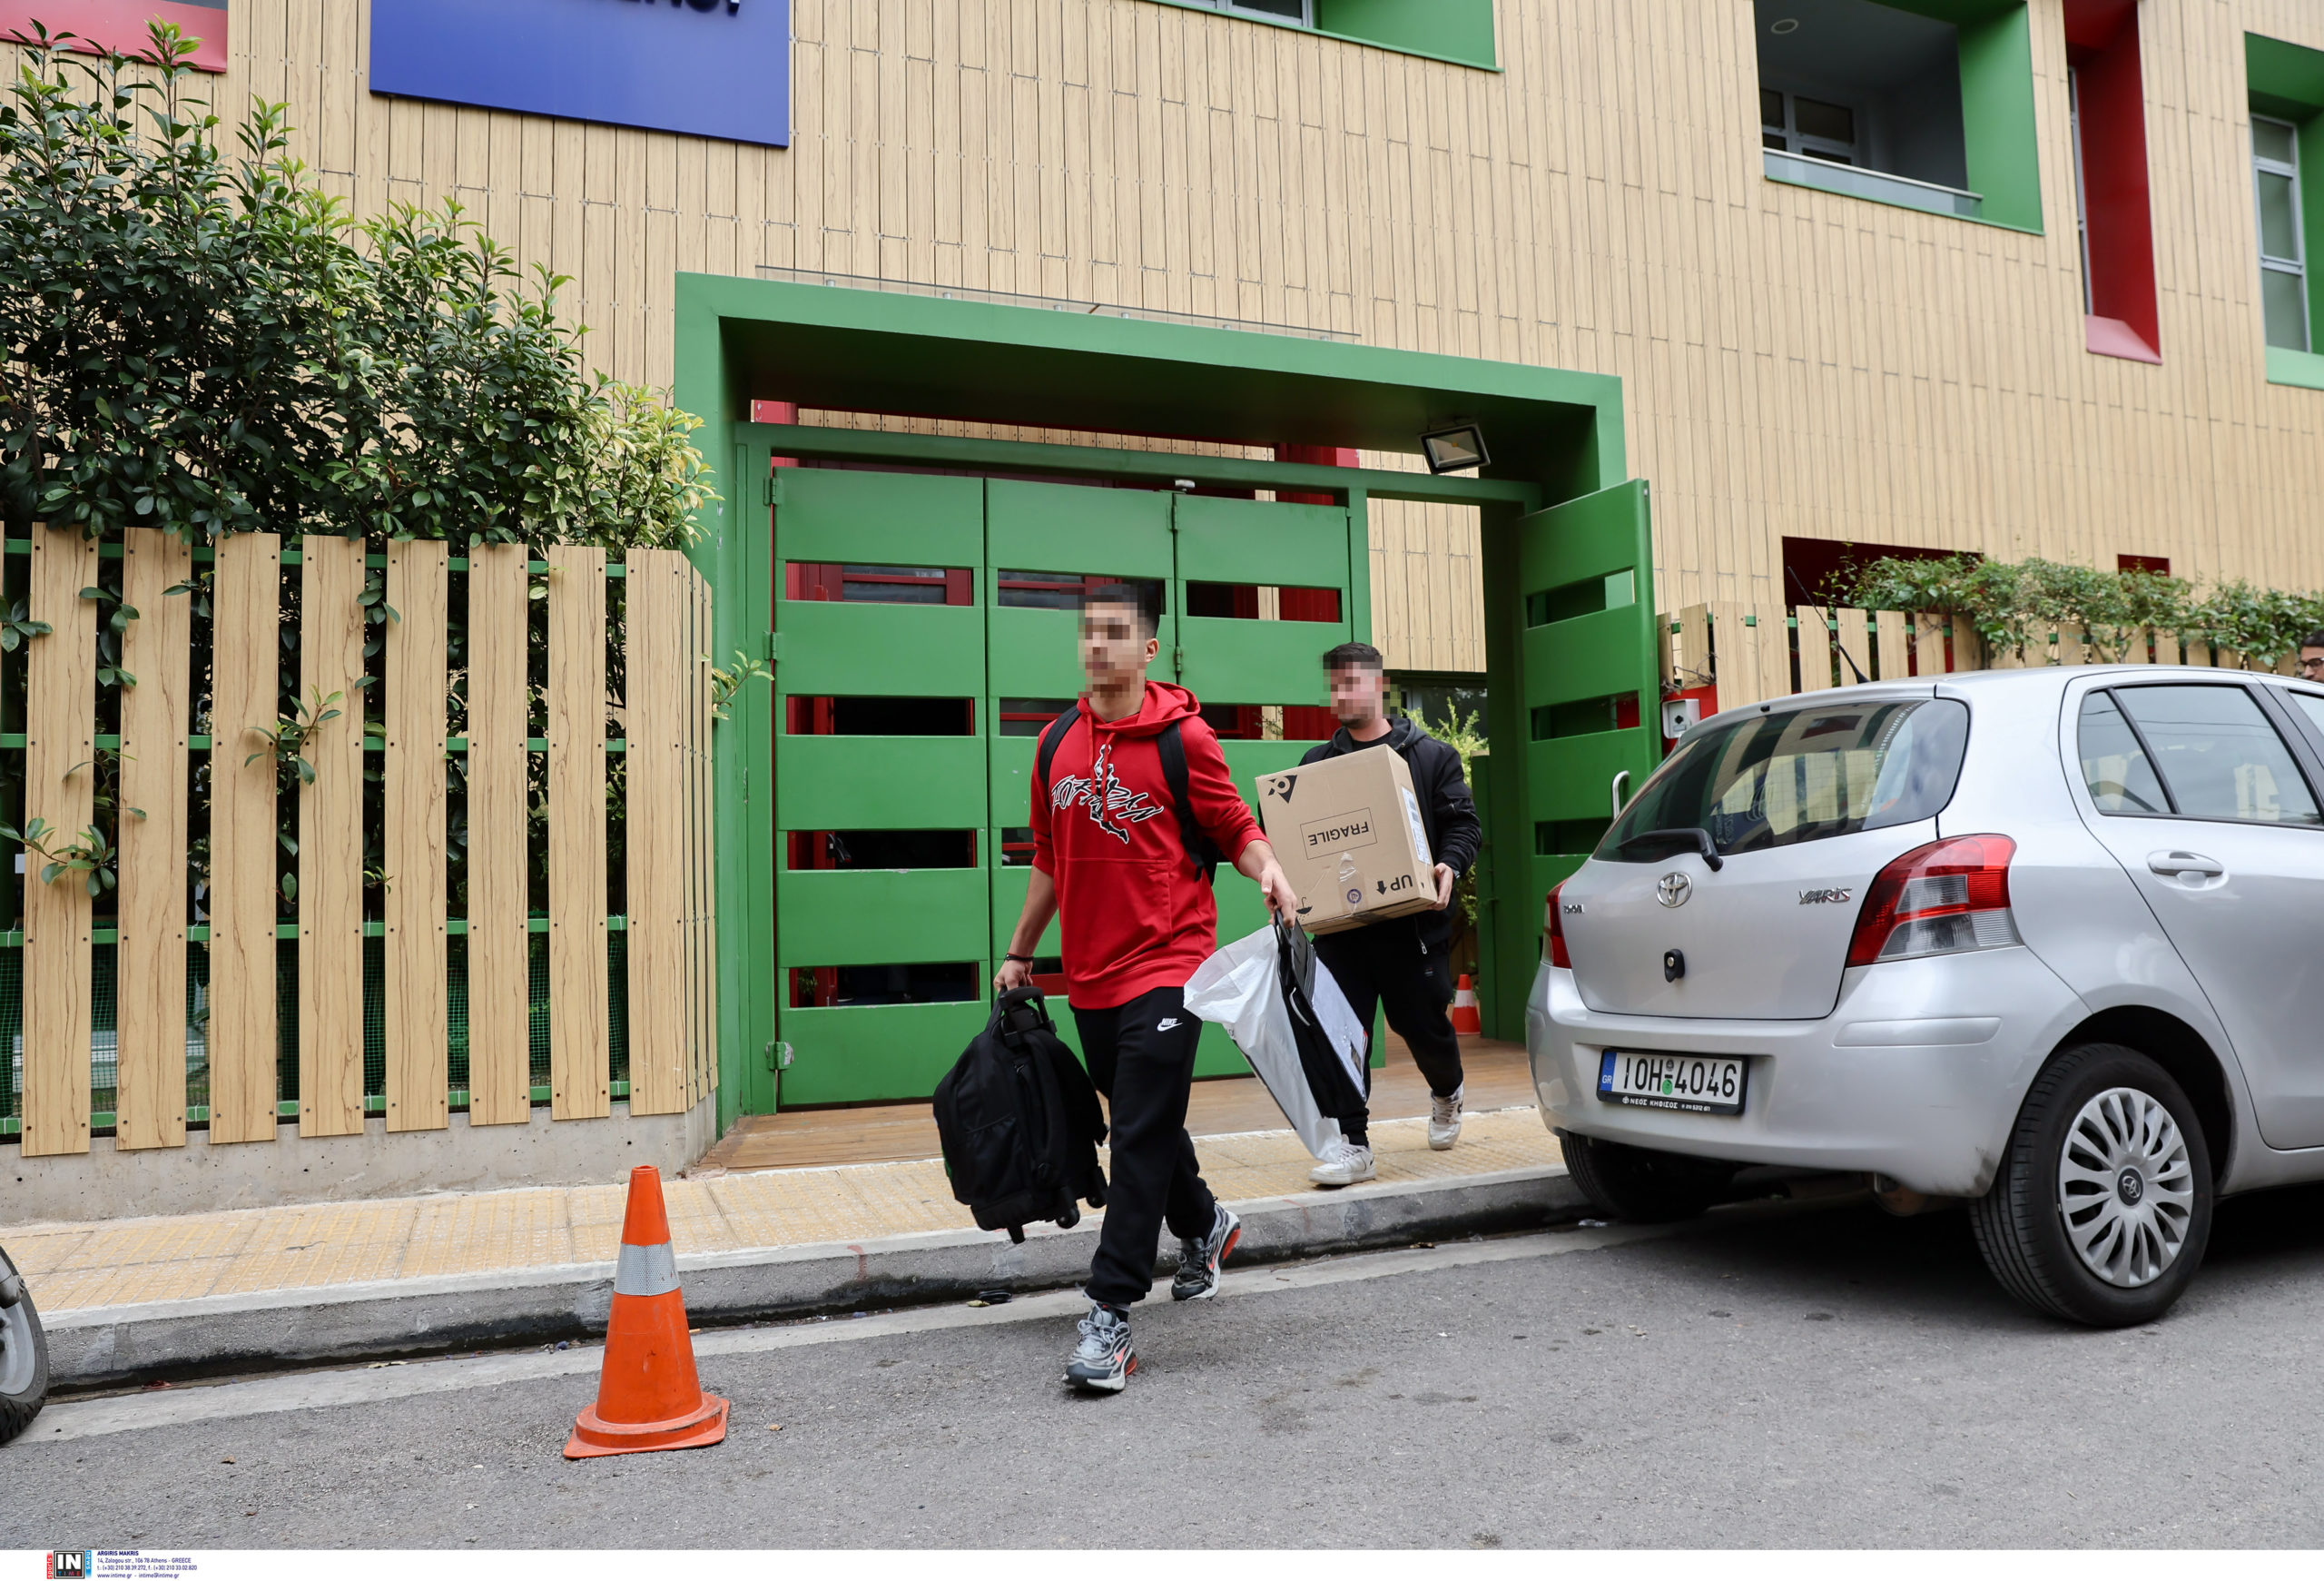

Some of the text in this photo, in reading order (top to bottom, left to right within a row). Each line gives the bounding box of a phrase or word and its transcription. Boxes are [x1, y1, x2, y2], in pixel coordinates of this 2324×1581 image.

[1309, 821, 1369, 845] FRAGILE
[1390, 874, 1413, 891] UP
[1161, 1017, 1177, 1026] NIKE
[1601, 1074, 1612, 1084] GR
